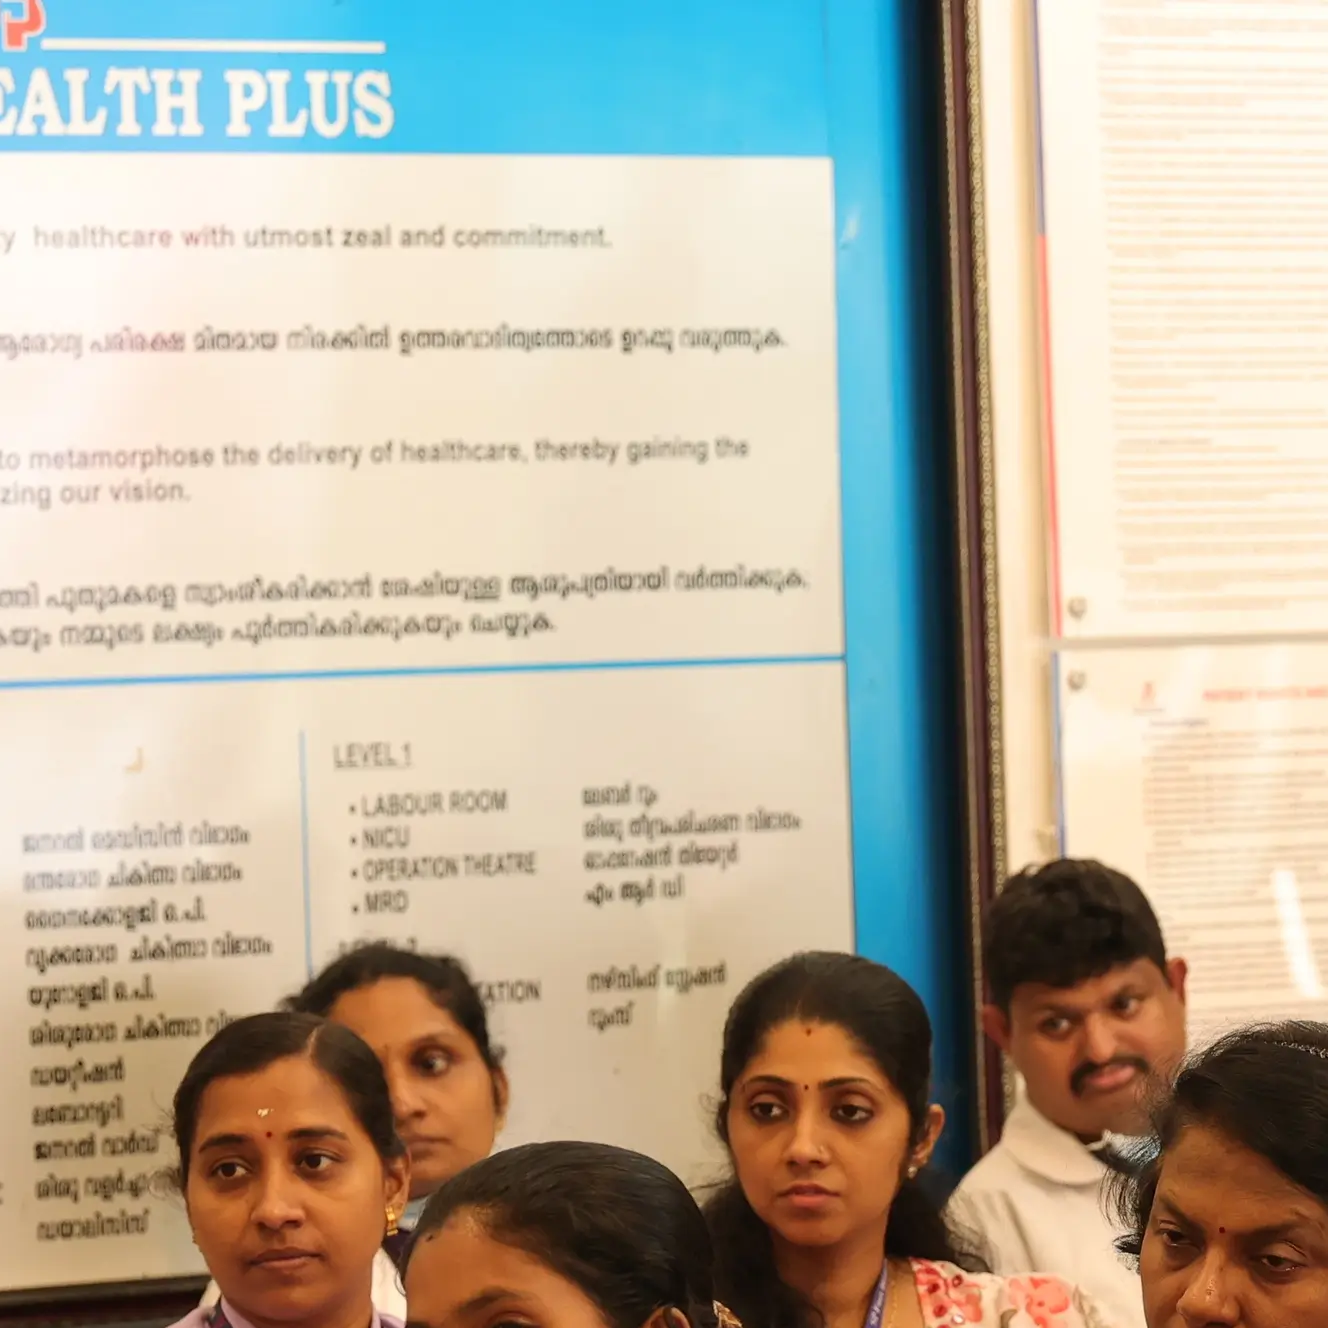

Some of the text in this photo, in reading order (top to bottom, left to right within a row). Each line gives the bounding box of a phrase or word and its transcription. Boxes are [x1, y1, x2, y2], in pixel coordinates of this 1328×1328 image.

[224, 69, 395, 139] PLUS
[33, 224, 173, 250] healthcare
[181, 224, 235, 248] with
[243, 225, 334, 249] utmost
[341, 223, 392, 249] zeal
[399, 224, 446, 249] and
[452, 226, 612, 250] commitment.
[29, 444, 215, 473] metamorphose
[221, 443, 261, 467] the
[267, 442, 363, 471] delivery
[369, 438, 394, 465] of
[400, 439, 528, 465] healthcare,
[534, 437, 620, 467] thereby
[626, 439, 711, 466] gaining
[714, 436, 750, 459] the
[59, 484, 101, 505] our
[109, 479, 190, 504] vision.
[333, 743, 413, 768] LEVEL 1
[361, 788, 507, 818] LABOUR ROOM
[362, 827, 410, 849] NICU
[363, 850, 538, 884] OPERATION THEATRE
[364, 889, 409, 914] MRD
